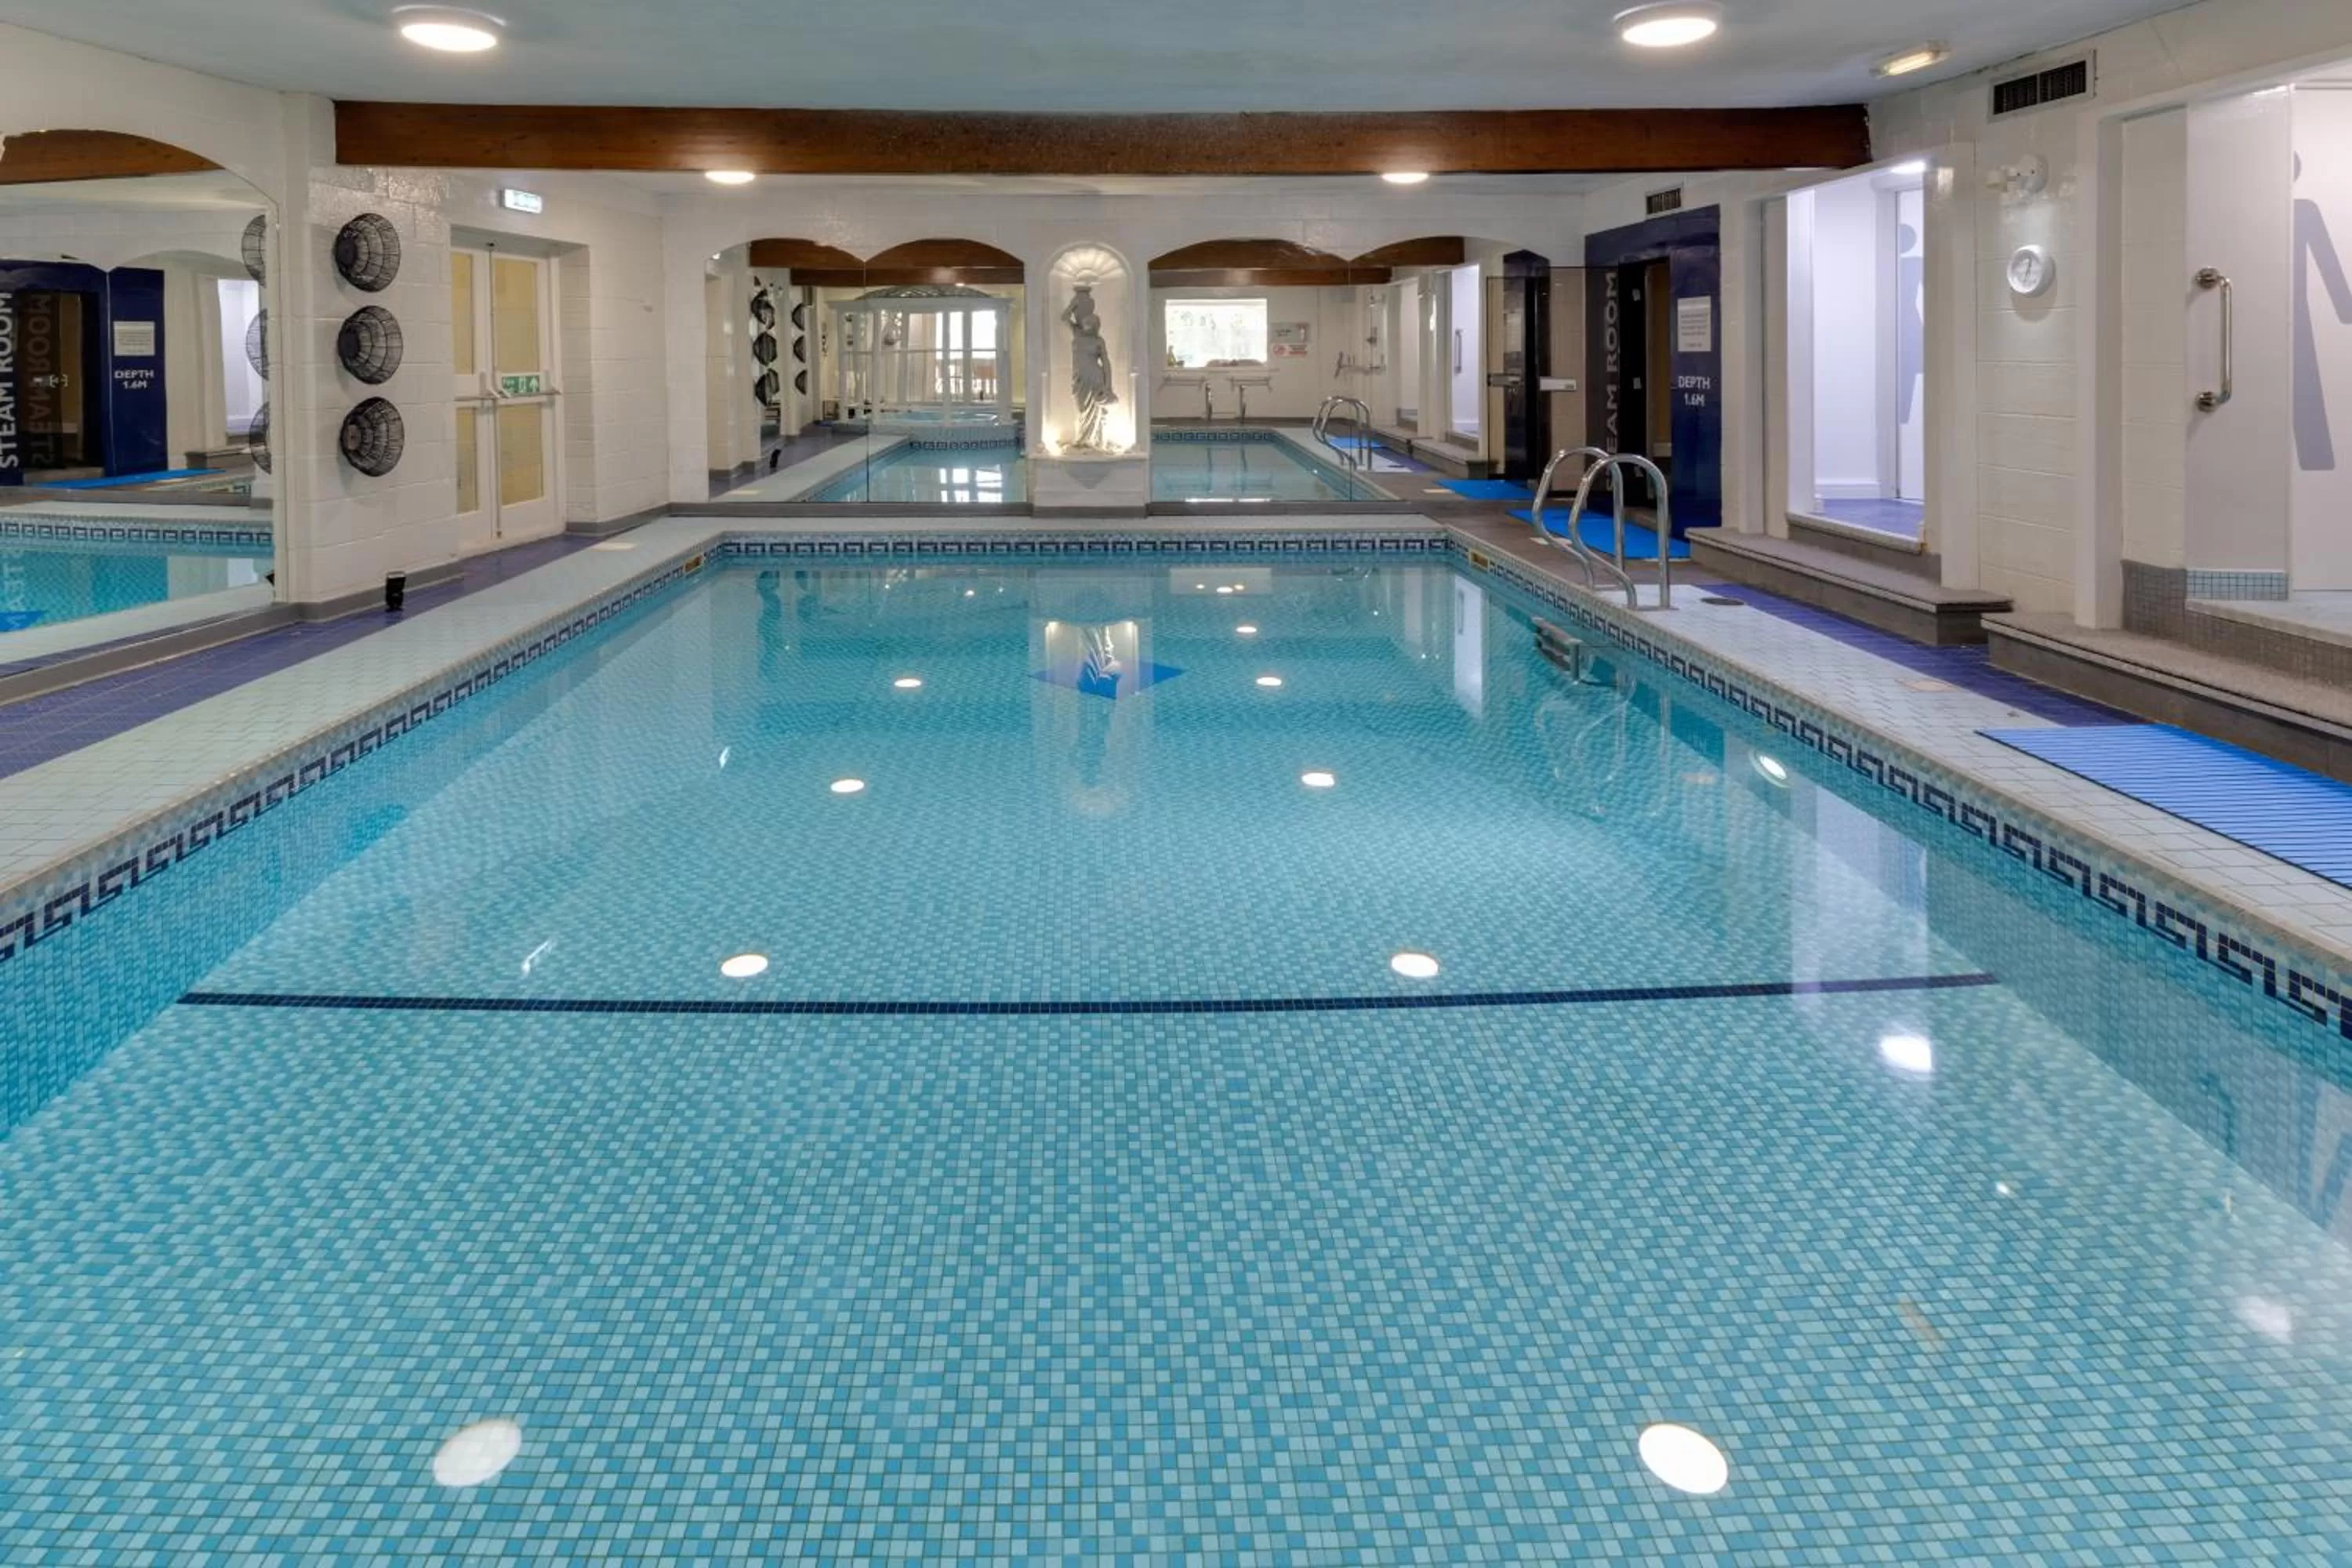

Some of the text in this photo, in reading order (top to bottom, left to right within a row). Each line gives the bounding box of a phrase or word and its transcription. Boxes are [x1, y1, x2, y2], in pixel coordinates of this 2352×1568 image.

[1605, 271, 1617, 372] ROOM
[114, 369, 154, 379] DEPTH
[1679, 376, 1710, 389] DEPTH
[1684, 393, 1704, 406] 1.6M
